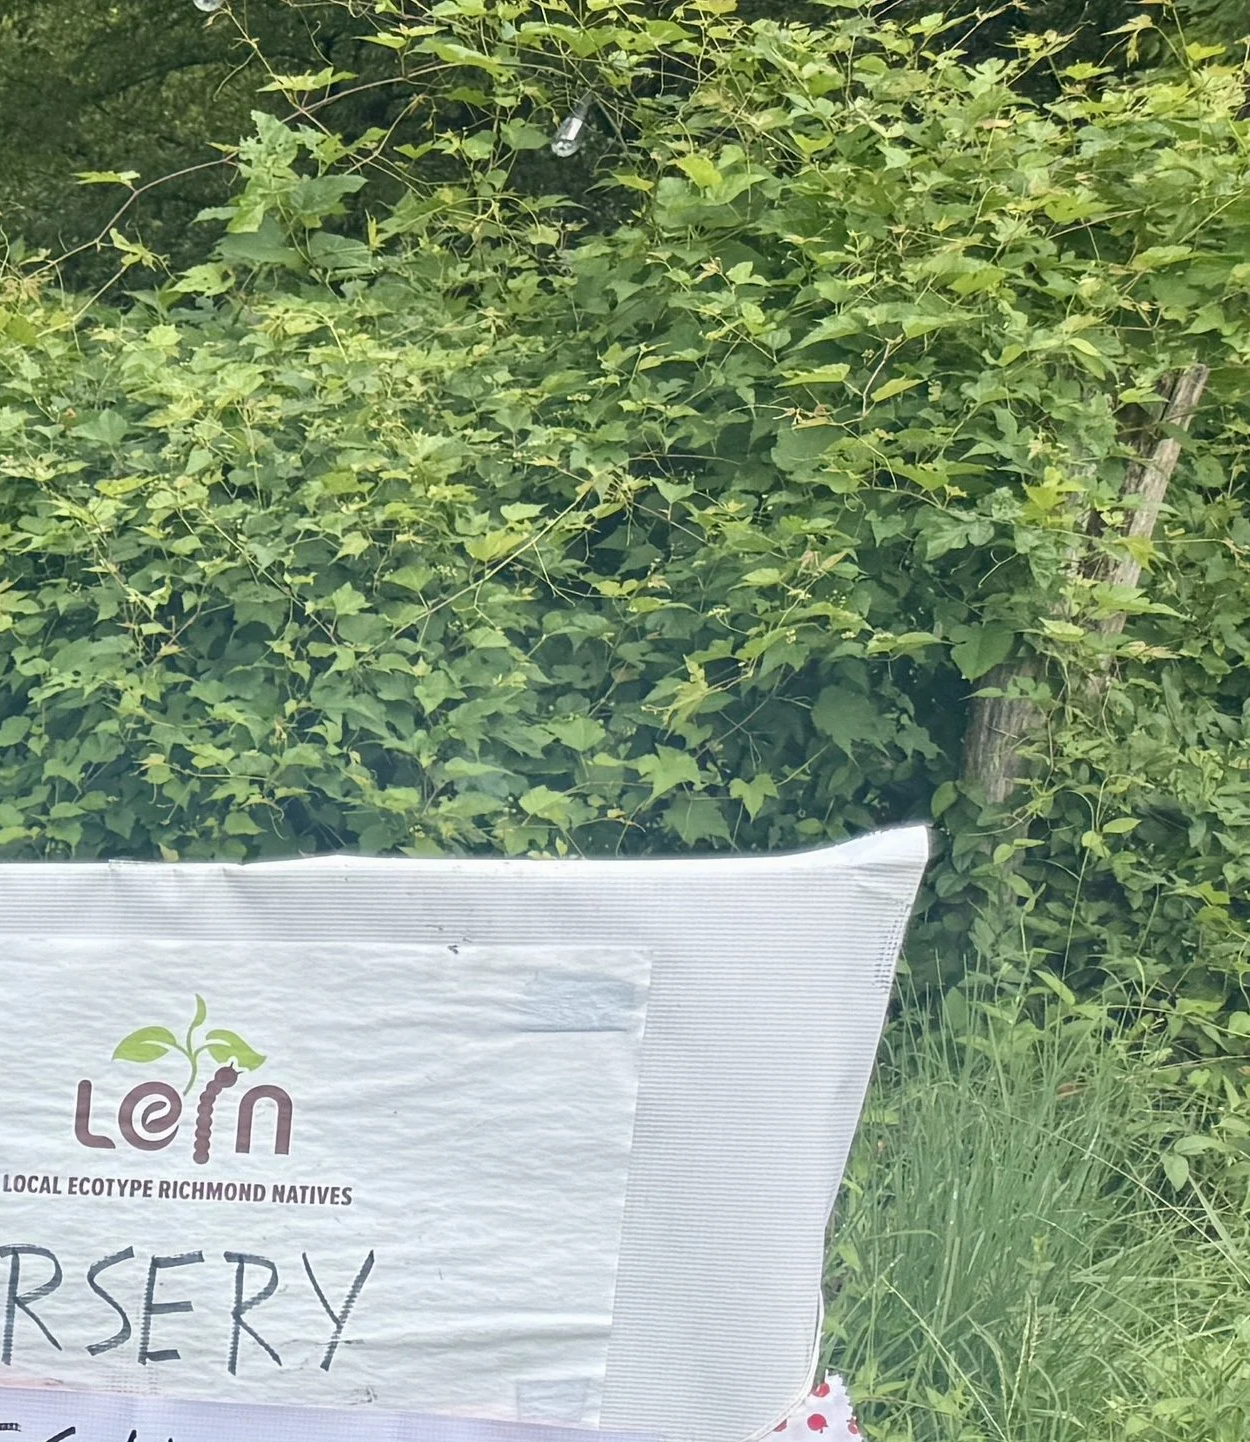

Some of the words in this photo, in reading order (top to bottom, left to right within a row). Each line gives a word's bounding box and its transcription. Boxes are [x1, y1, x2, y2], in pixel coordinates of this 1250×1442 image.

[3, 1174, 62, 1195] LOCAL
[68, 1176, 152, 1198] ECOTYPE
[158, 1180, 266, 1203] RICHMOND
[271, 1184, 353, 1206] NATIVES
